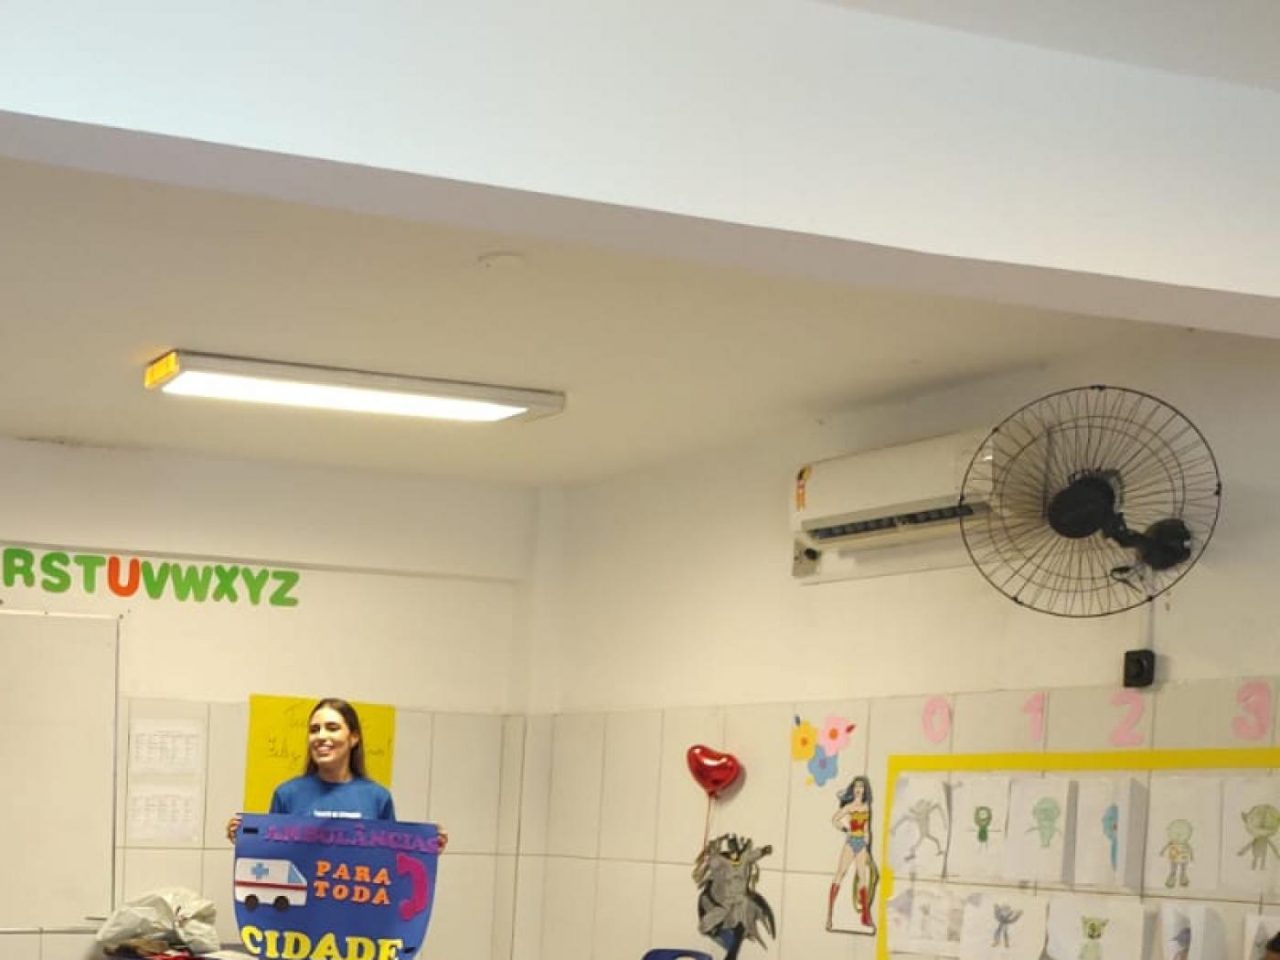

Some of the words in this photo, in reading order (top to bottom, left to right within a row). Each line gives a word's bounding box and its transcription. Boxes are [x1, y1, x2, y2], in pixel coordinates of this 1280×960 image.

[922, 694, 951, 743] 0
[1022, 690, 1045, 742] 1
[1108, 687, 1145, 747] 2
[1231, 680, 1273, 740] 3
[315, 860, 392, 885] PARA
[314, 880, 391, 905] TODA
